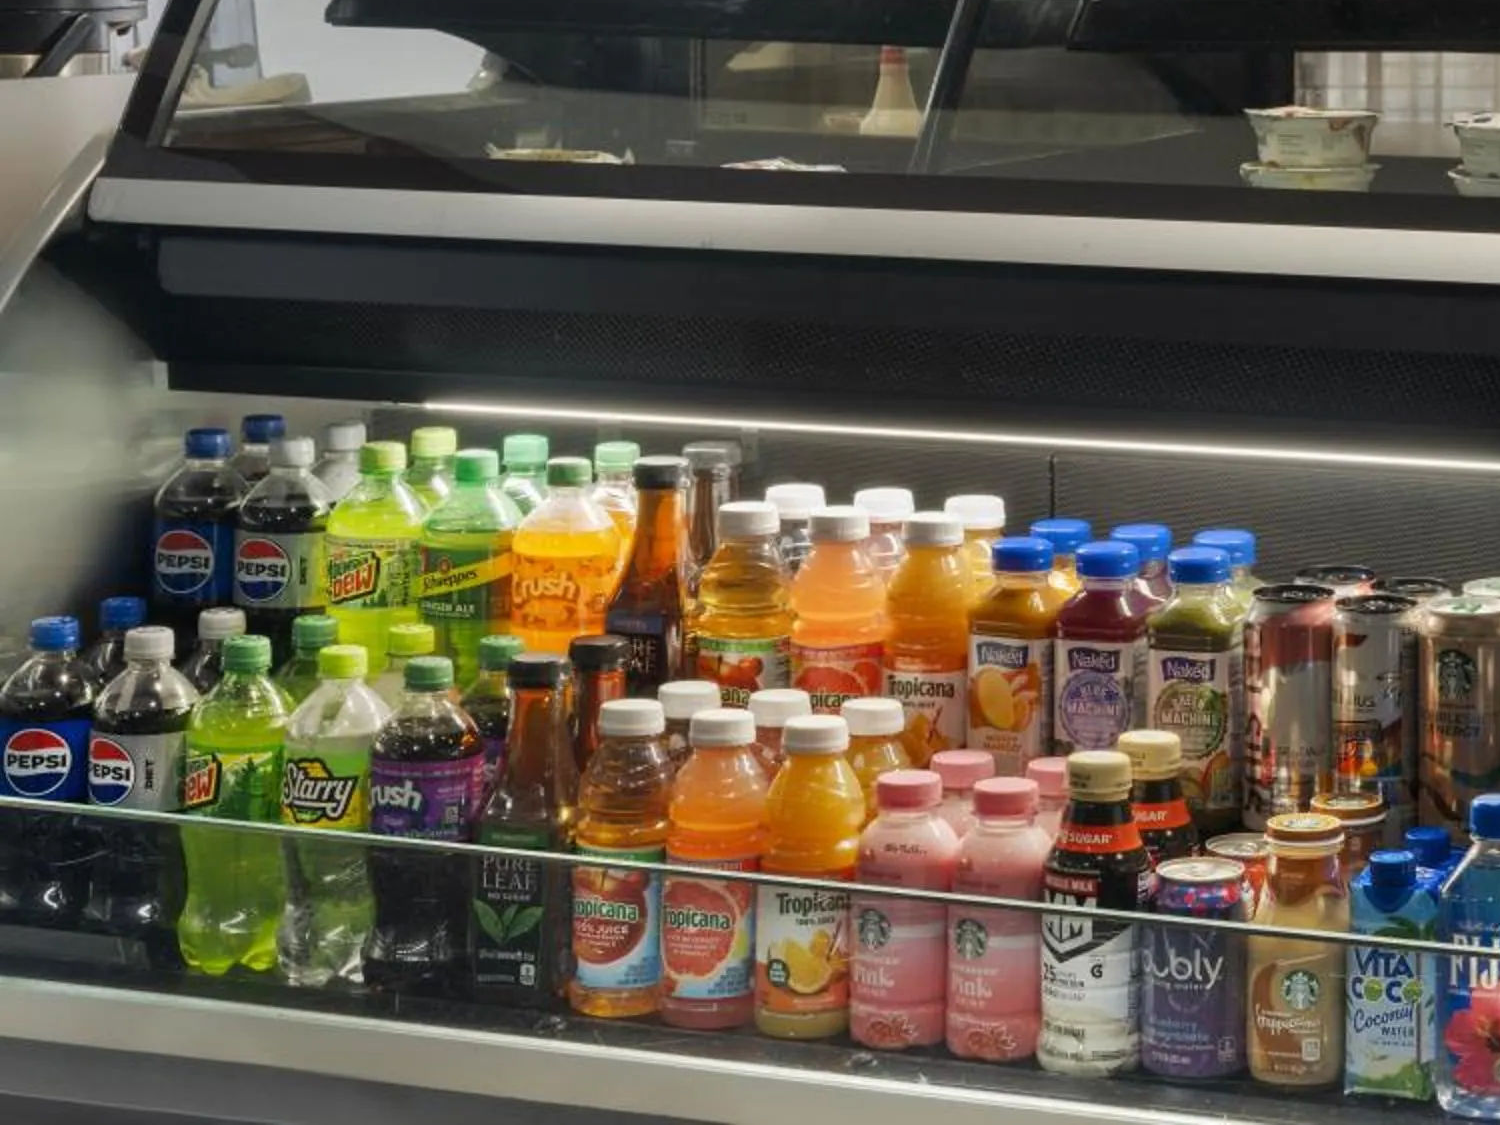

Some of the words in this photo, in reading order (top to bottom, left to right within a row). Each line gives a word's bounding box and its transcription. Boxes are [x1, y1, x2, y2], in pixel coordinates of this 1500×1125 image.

[157, 552, 210, 570] PEPSI
[238, 560, 288, 577] PEPSI
[981, 646, 1025, 665] Naked
[1072, 650, 1116, 669] Naked
[1167, 659, 1211, 679] Naked
[886, 675, 954, 698] Tropicana
[7, 754, 66, 769] PEPSI
[90, 763, 130, 781] EPSI
[283, 762, 355, 818] Starry
[371, 779, 422, 811] rush
[481, 854, 539, 872] PURE
[481, 872, 538, 891] LEAF
[574, 897, 639, 924] opicana
[1354, 946, 1414, 978] VITA
